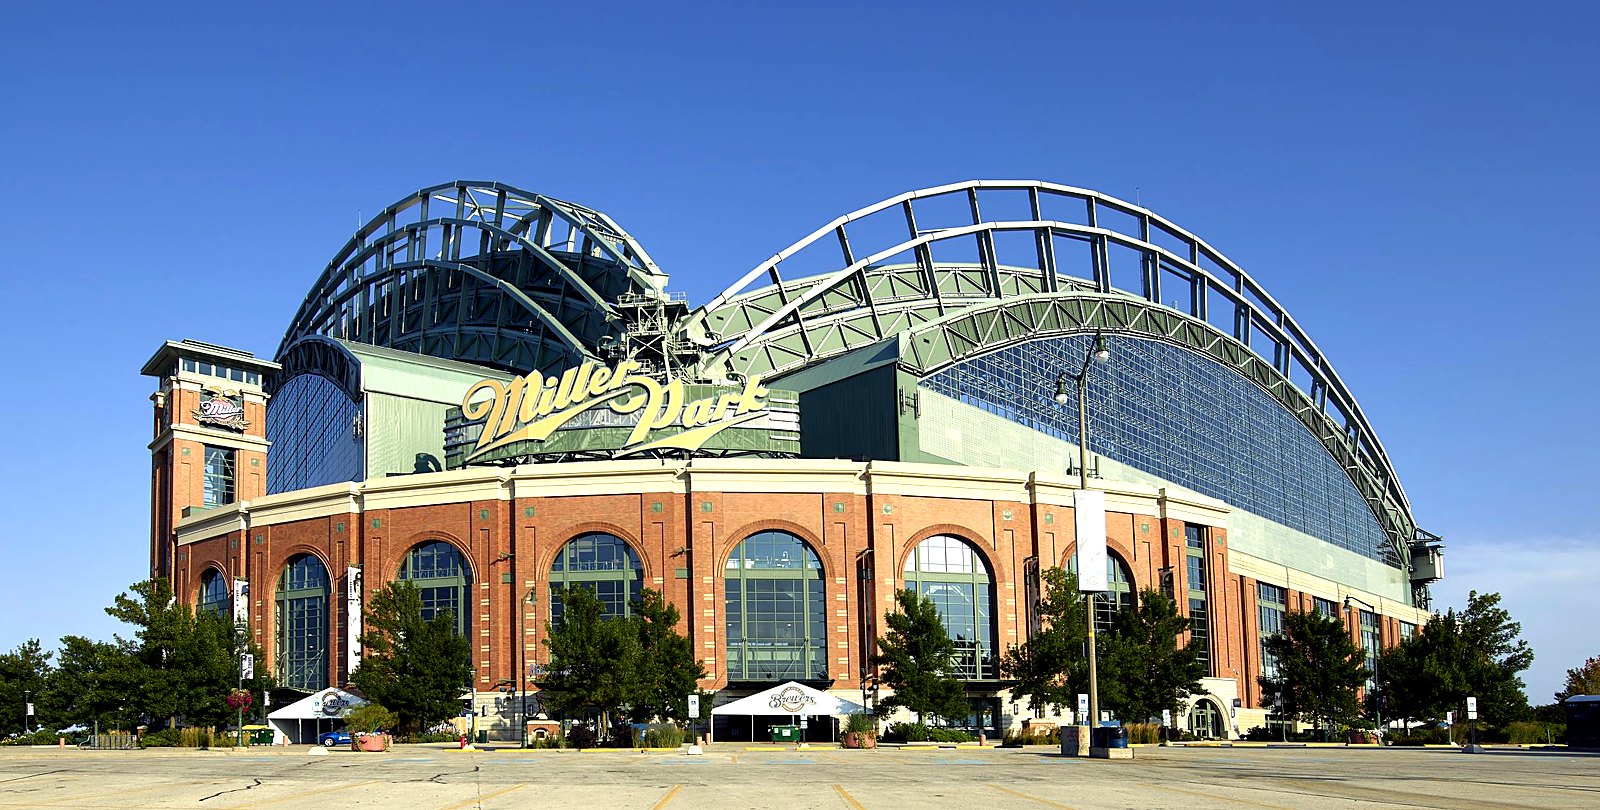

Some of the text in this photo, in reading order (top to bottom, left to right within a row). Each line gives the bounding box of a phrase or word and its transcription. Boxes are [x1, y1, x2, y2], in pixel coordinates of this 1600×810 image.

[200, 401, 243, 417] Miller
[462, 361, 770, 457] Miller Park
[769, 693, 815, 709] Brewers
